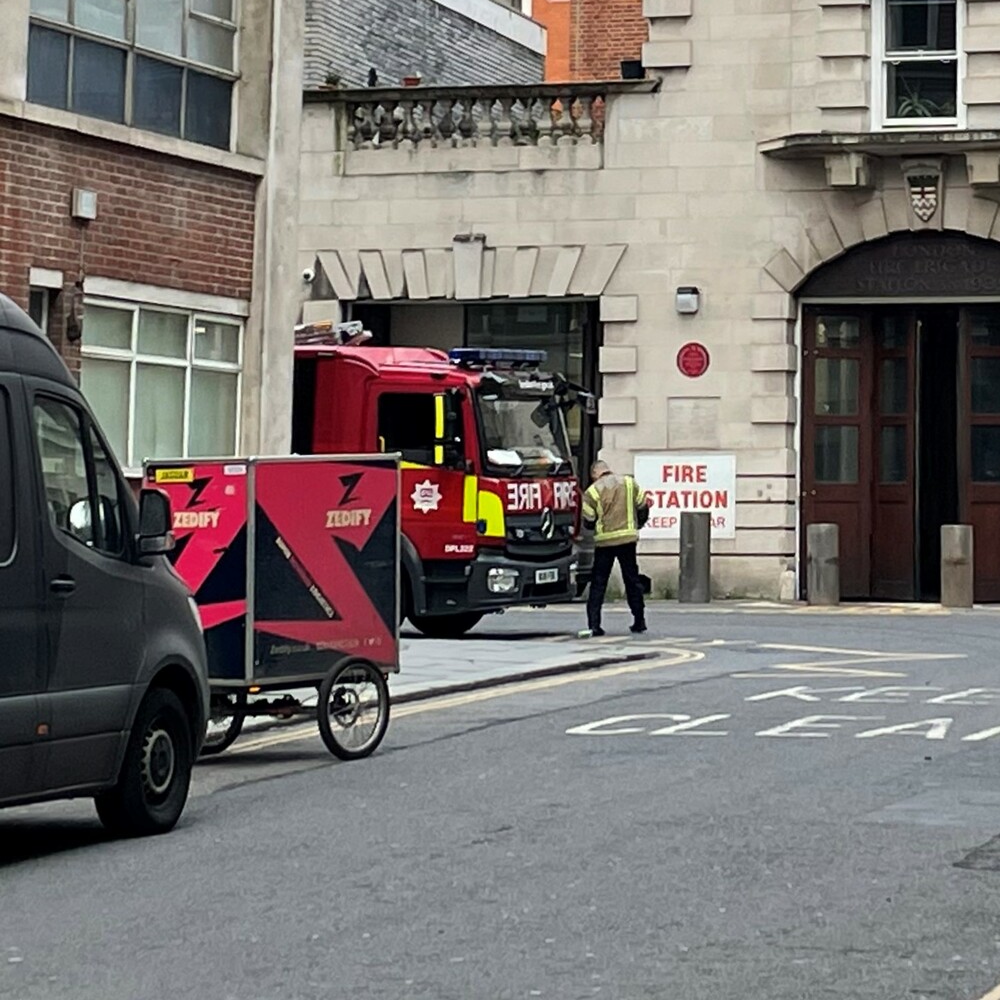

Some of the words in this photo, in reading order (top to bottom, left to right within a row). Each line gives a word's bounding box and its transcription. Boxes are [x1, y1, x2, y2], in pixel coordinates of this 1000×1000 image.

[662, 465, 707, 483] FIRE
[643, 490, 728, 508] STATION
[173, 511, 221, 529] ZEDIFY
[325, 508, 372, 529] ZEDIFY
